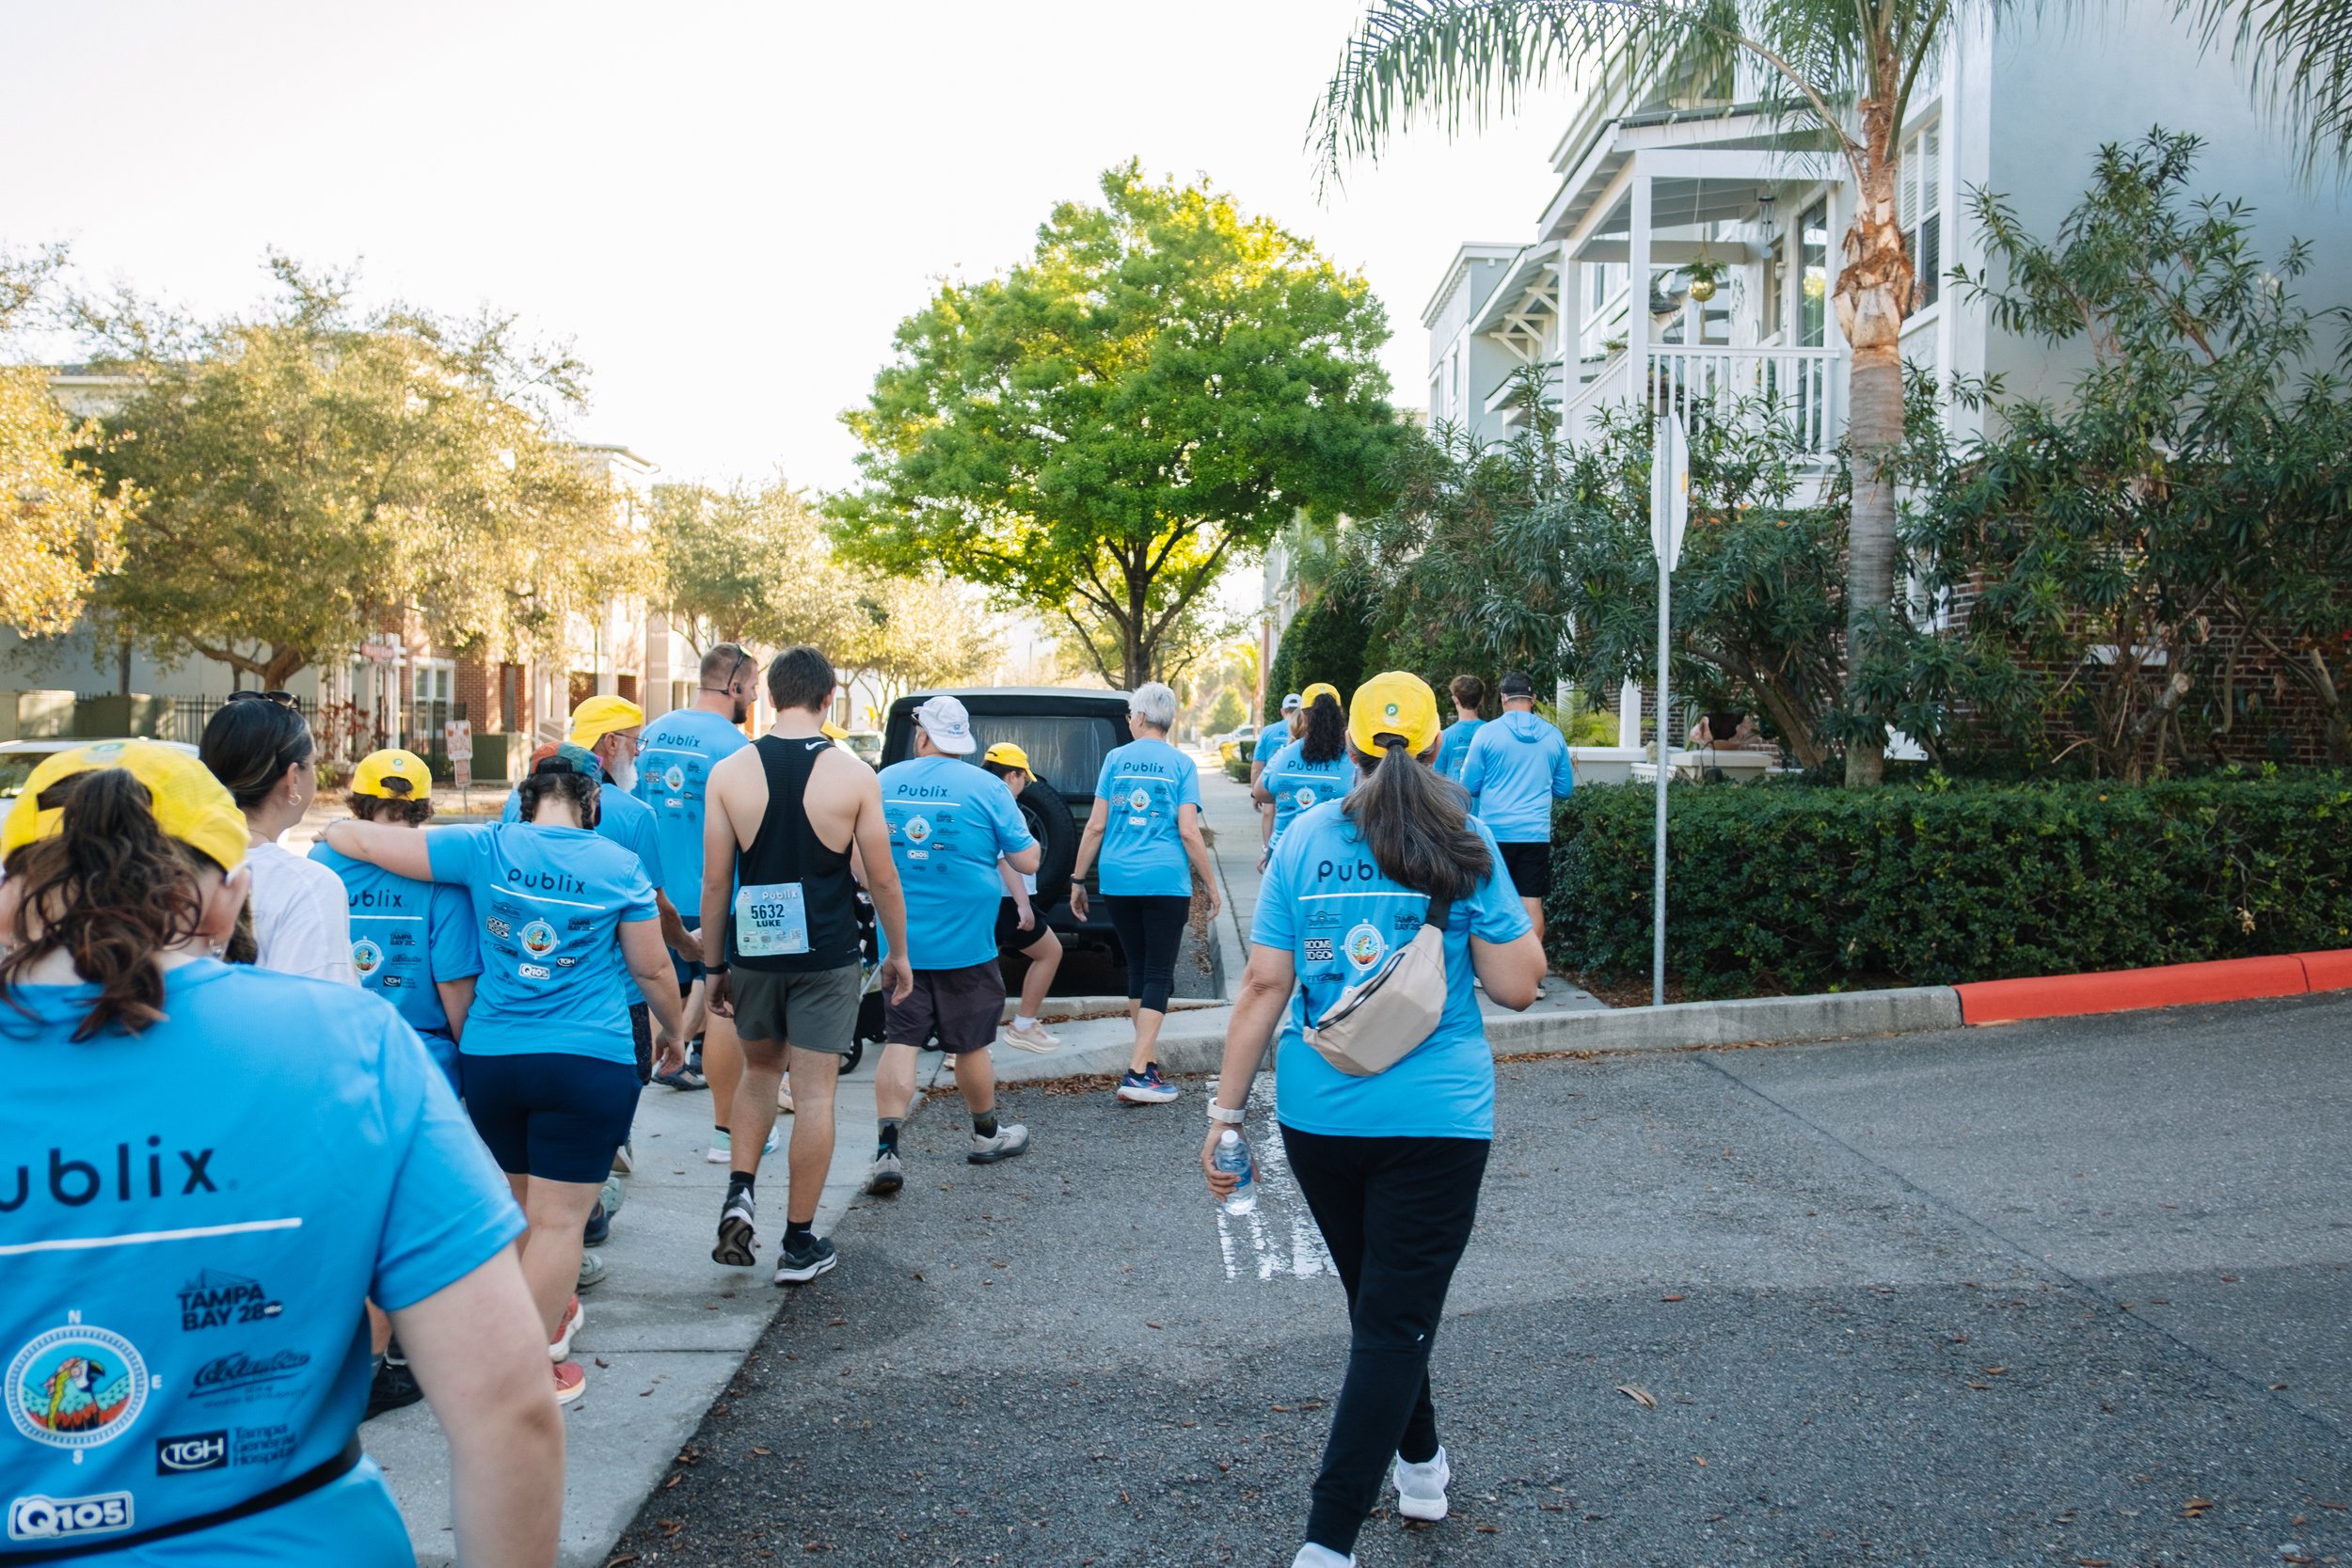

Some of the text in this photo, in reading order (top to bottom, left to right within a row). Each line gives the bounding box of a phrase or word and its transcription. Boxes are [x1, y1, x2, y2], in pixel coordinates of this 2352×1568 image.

[657, 733, 701, 748] Publix
[1122, 762, 1165, 773] Publix
[1287, 760, 1331, 771] Publix
[897, 784, 948, 797] Publix
[1318, 859, 1383, 883] Publ
[508, 868, 585, 895] Publix
[349, 889, 403, 908] ublix
[762, 889, 798, 900] Publix
[751, 904, 785, 920] 5632
[1304, 940, 1331, 949] ROOMS
[520, 963, 548, 977] Q105
[0, 1133, 218, 1213] ublix
[177, 1283, 265, 1311] TAMPA
[68, 1310, 82, 1324] N
[182, 1307, 232, 1332] BAY
[151, 1375, 163, 1388] E
[234, 1422, 288, 1440] Tampa
[168, 1437, 224, 1463] TGH
[233, 1432, 296, 1453] General
[72, 1449, 83, 1465] S
[17, 1497, 125, 1537] Q105
